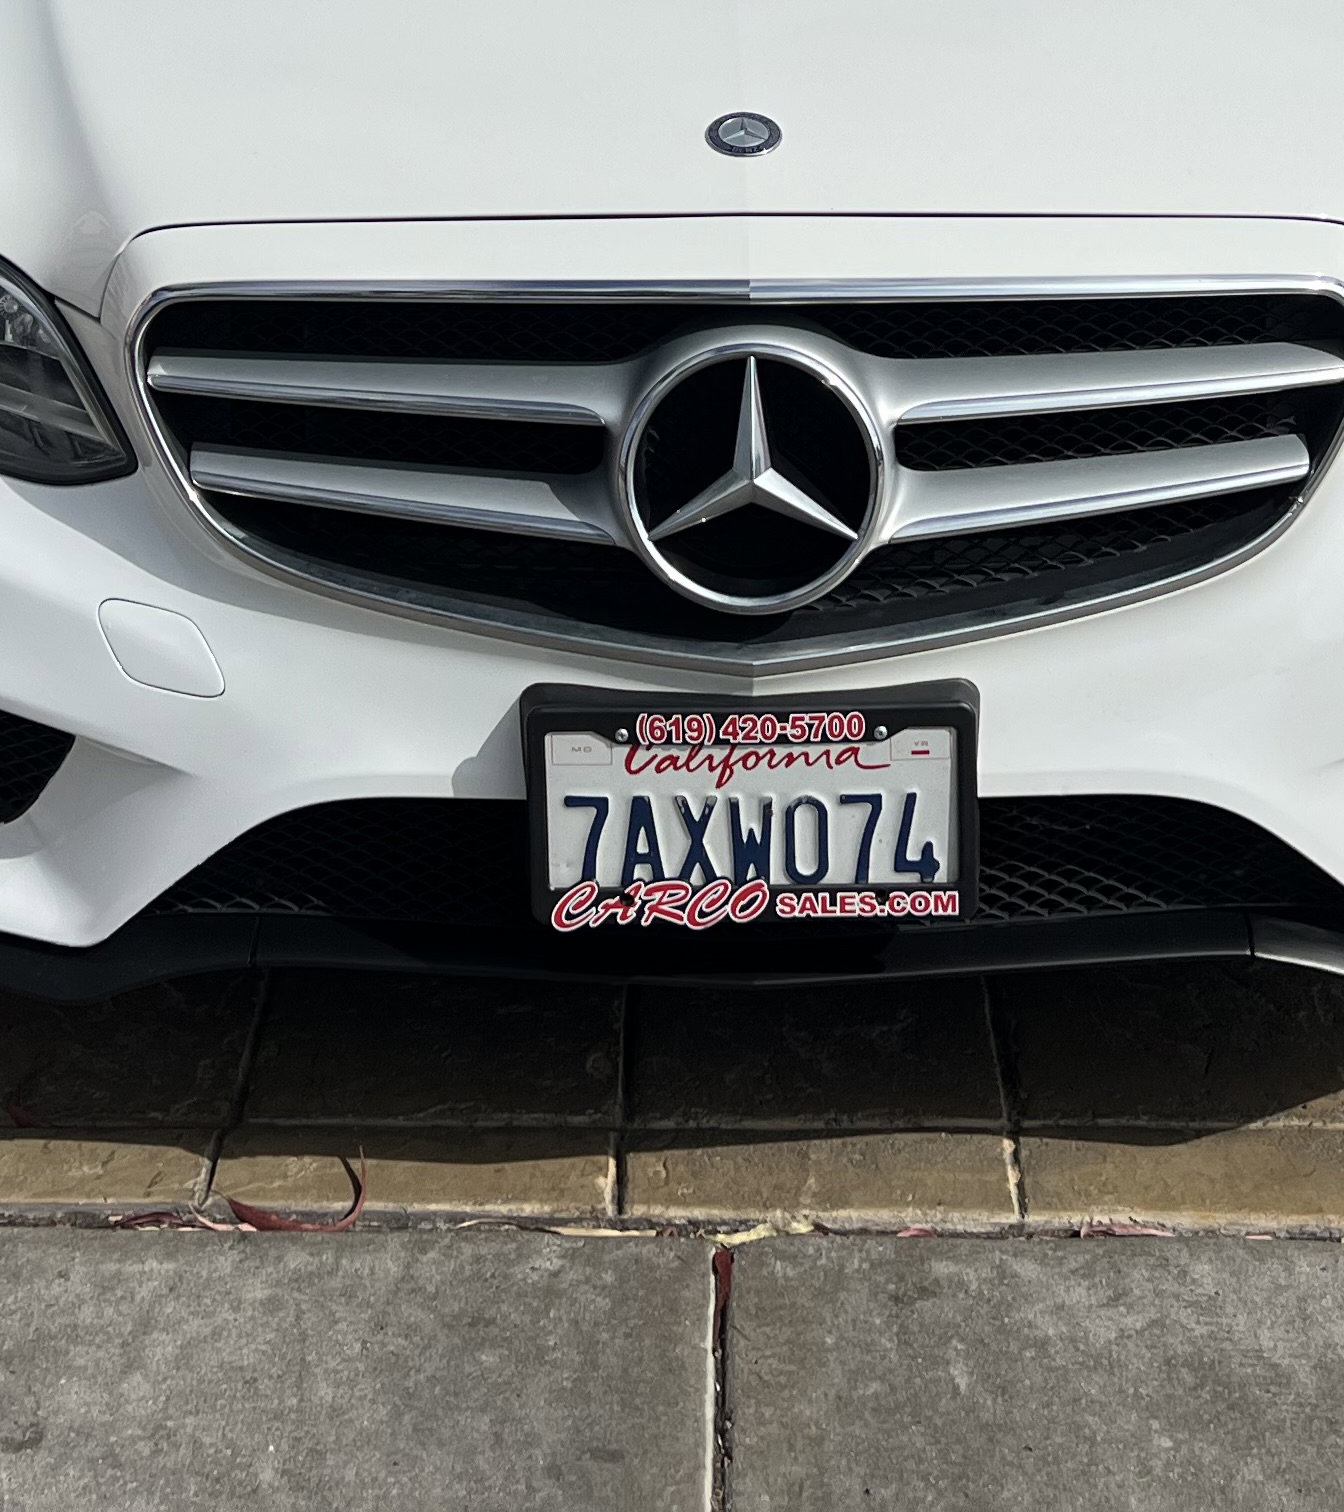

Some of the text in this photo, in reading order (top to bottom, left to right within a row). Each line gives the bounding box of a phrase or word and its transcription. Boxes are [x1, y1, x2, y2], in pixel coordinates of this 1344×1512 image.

[635, 712, 866, 745] (619) 420-5700
[624, 742, 892, 789] California
[563, 792, 941, 886] 7AXW074
[552, 878, 960, 932] CARCO SALES.COM
